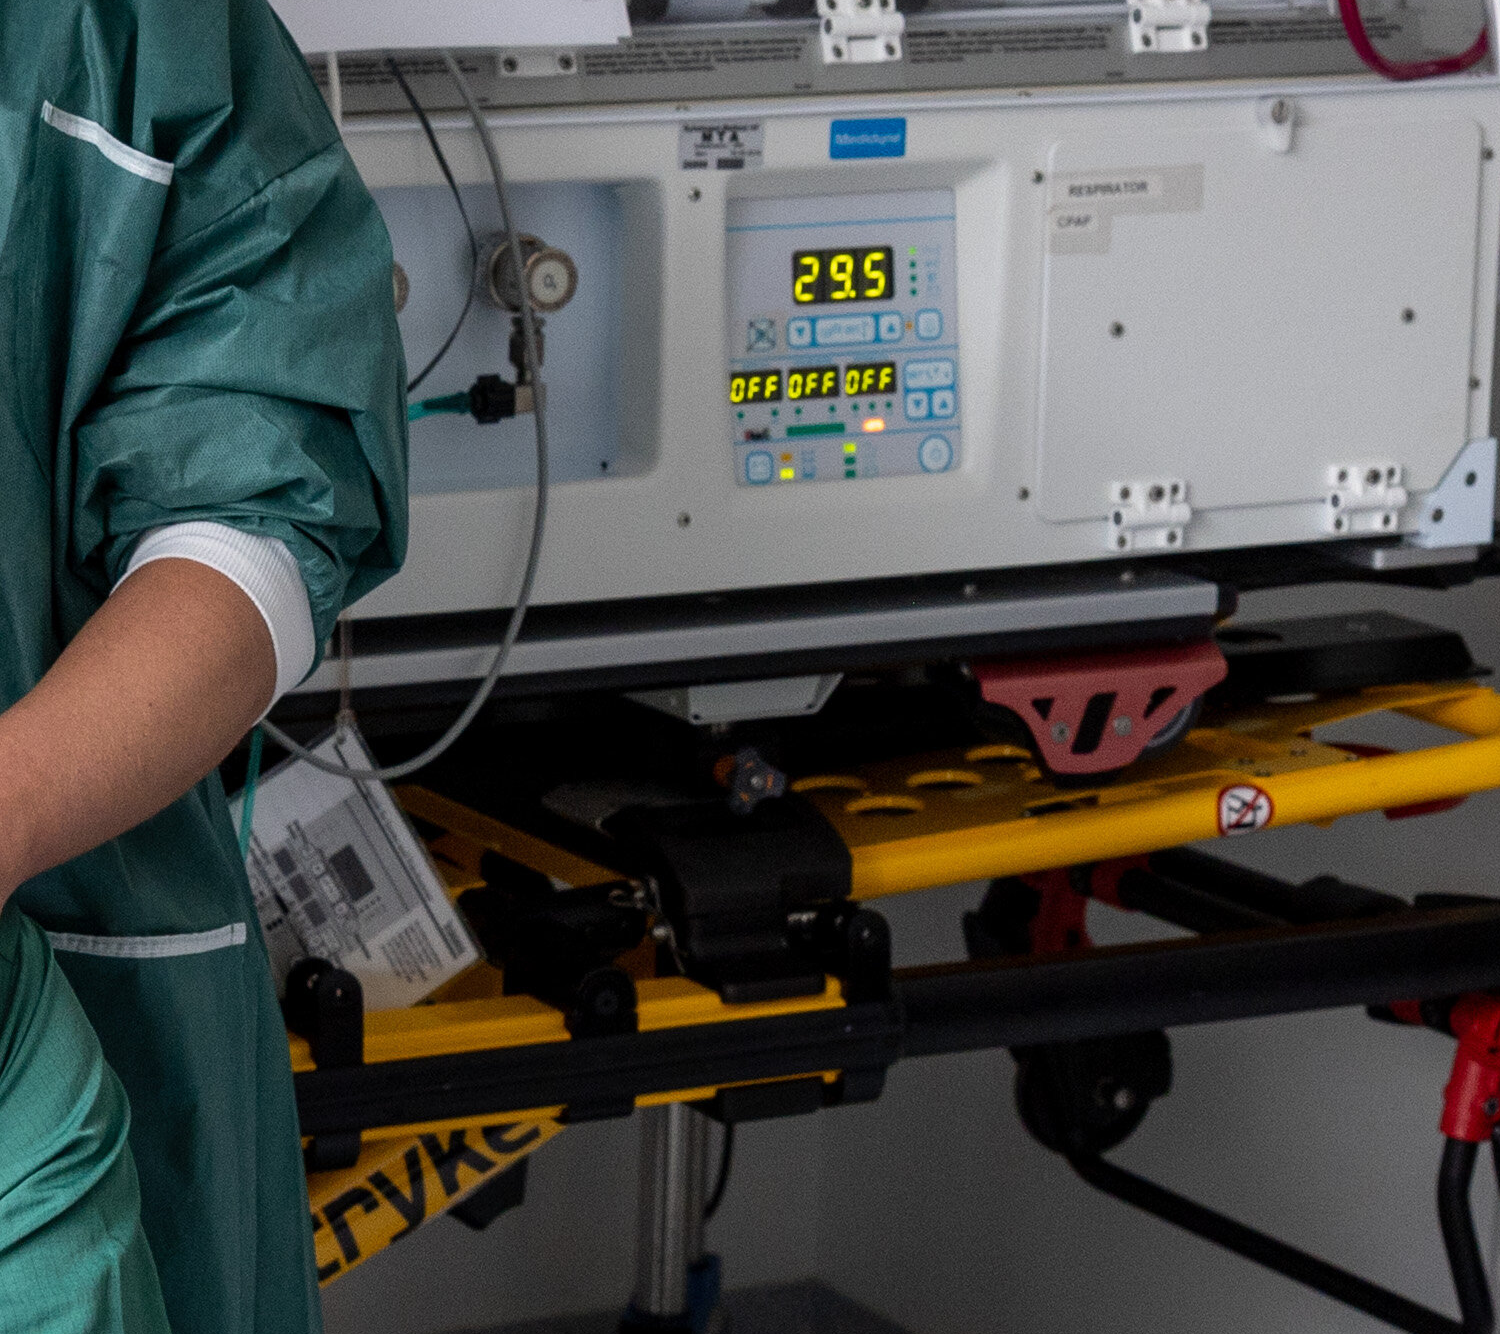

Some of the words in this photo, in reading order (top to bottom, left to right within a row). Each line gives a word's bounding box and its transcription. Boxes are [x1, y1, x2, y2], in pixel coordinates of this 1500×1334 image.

[1069, 180, 1148, 197] RESPIRATOR
[794, 250, 887, 303] 29.5
[730, 374, 779, 403] OFF
[788, 371, 836, 399] OFF
[845, 367, 894, 396] OFF
